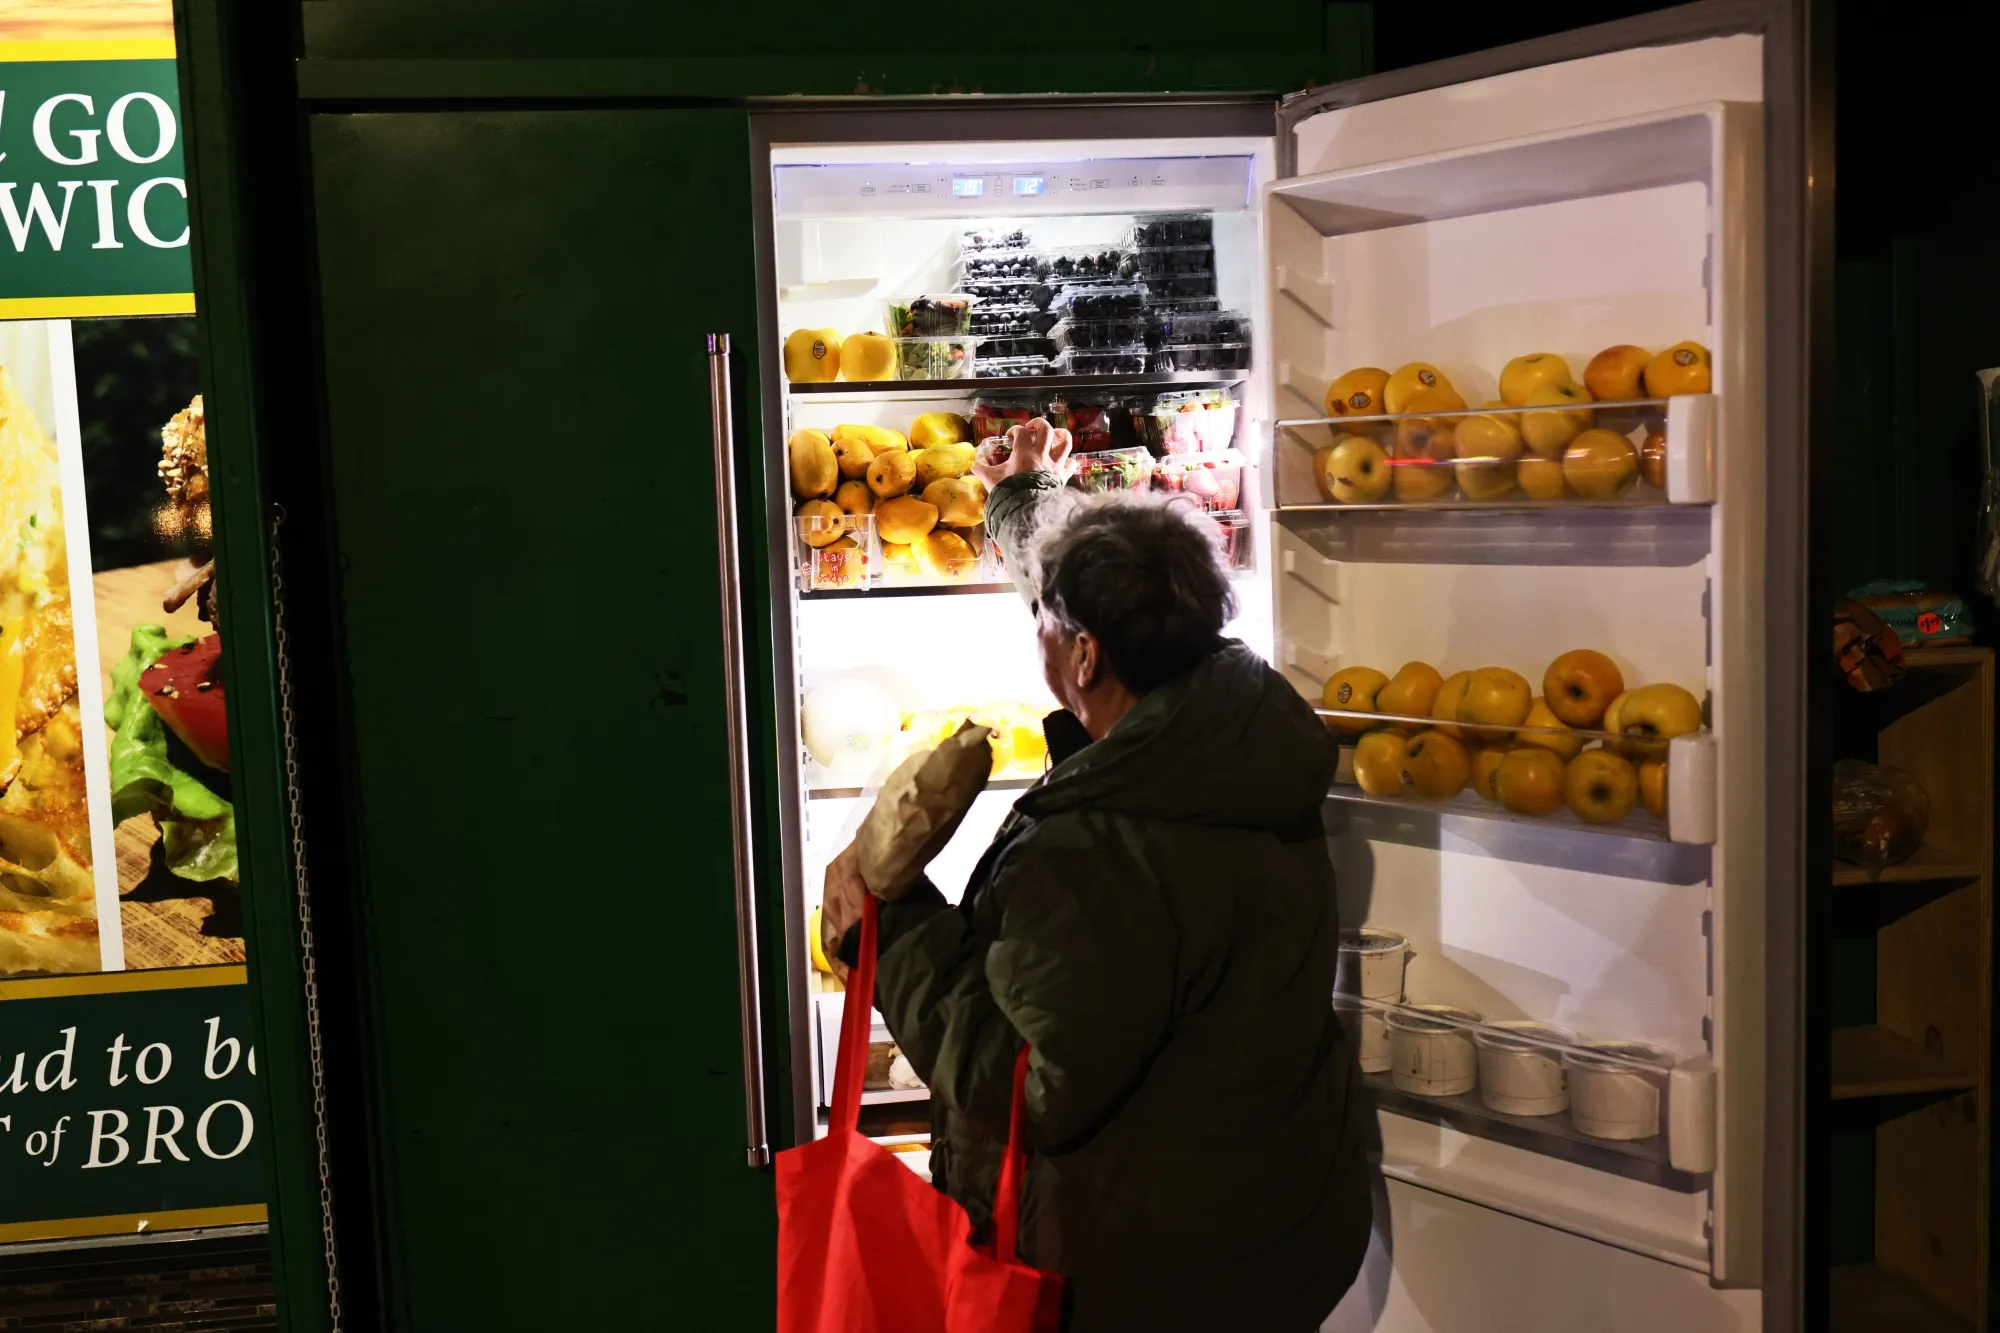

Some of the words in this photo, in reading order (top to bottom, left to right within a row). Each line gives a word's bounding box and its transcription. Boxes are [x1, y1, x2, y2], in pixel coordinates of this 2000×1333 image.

[33, 92, 176, 165] GO
[0, 177, 190, 252] WIC
[107, 1033, 172, 1087] to
[25, 1116, 71, 1167] of
[81, 1099, 254, 1169] BRO
